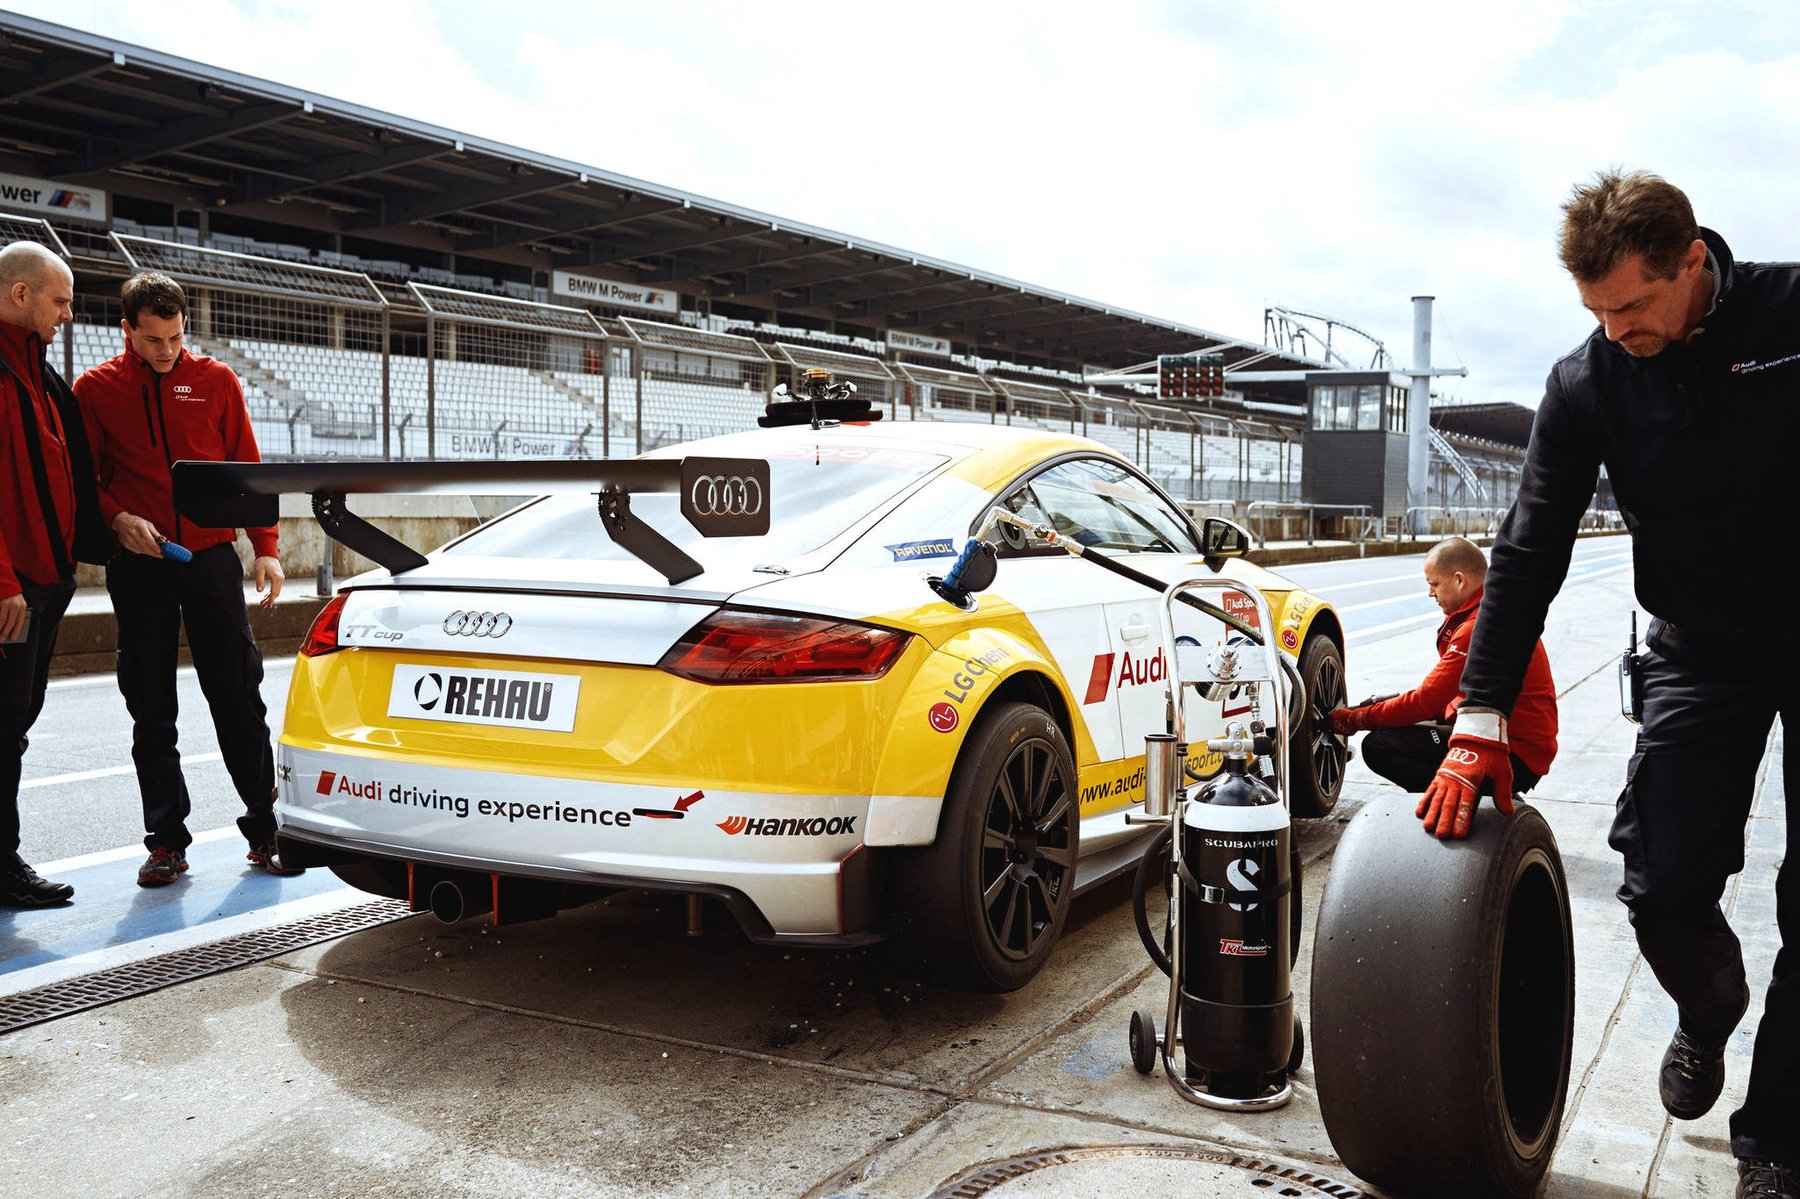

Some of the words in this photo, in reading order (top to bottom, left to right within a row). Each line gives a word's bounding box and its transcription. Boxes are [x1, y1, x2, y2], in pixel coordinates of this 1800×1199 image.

[0, 184, 42, 204] wer
[568, 278, 597, 295] BMW
[599, 283, 609, 297] M
[611, 285, 643, 303] Power
[452, 435, 491, 454] BMW
[493, 439, 507, 455] M
[512, 438, 556, 456] Power
[894, 543, 953, 558] RAVENOL
[346, 625, 377, 638] TT
[374, 631, 404, 643] cup
[944, 671, 975, 704] LG
[964, 647, 1010, 676] Chem
[1117, 646, 1168, 688] Audi
[444, 675, 553, 722] REHAU
[338, 775, 382, 801] Audi
[388, 784, 469, 818] driving
[477, 799, 632, 828] experience
[1204, 838, 1279, 849] SCUBAPRO
